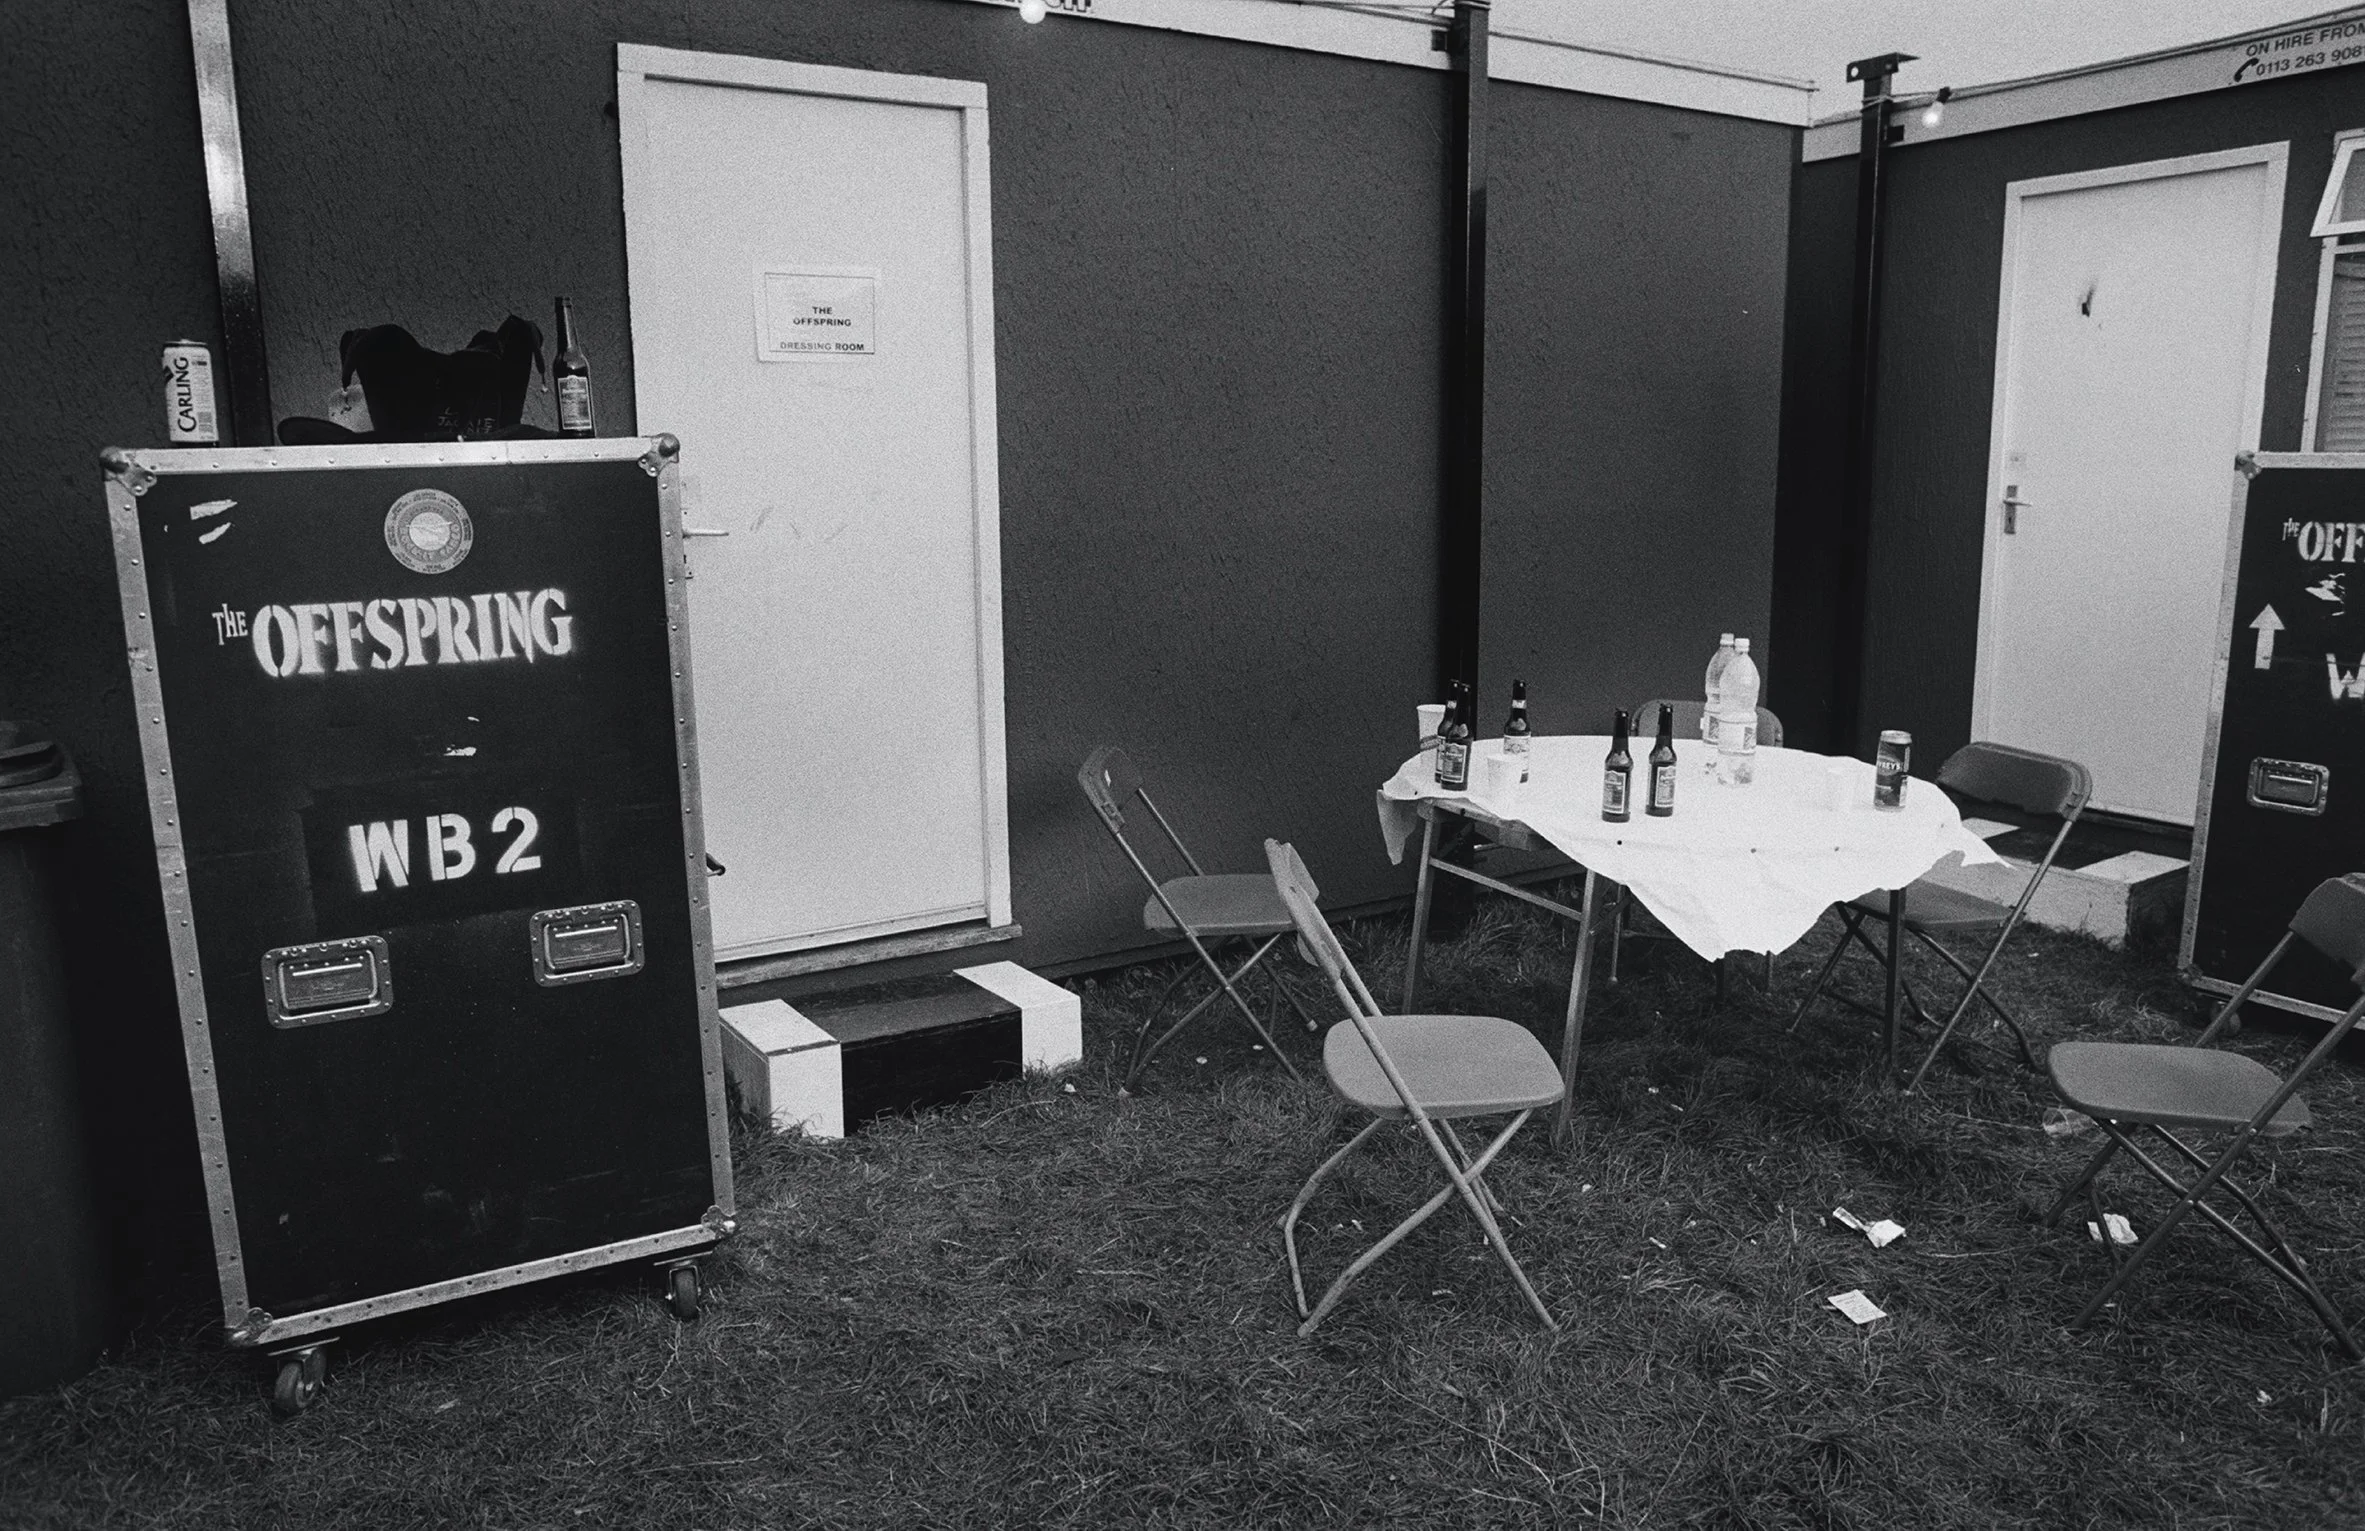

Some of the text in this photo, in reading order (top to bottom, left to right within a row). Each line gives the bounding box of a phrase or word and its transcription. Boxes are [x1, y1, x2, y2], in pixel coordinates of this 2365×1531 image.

[2246, 40, 2270, 57] ON
[2275, 32, 2314, 52] HIRE
[2256, 58, 2290, 76] 0113
[2295, 51, 2326, 69] 263
[793, 317, 852, 327] OFFSPRING
[812, 306, 833, 315] THE
[780, 341, 865, 352] DRESSING ROOM
[173, 356, 197, 433] CARLING
[2297, 521, 2365, 562] OFF
[212, 588, 573, 678] THE OFFSPRING
